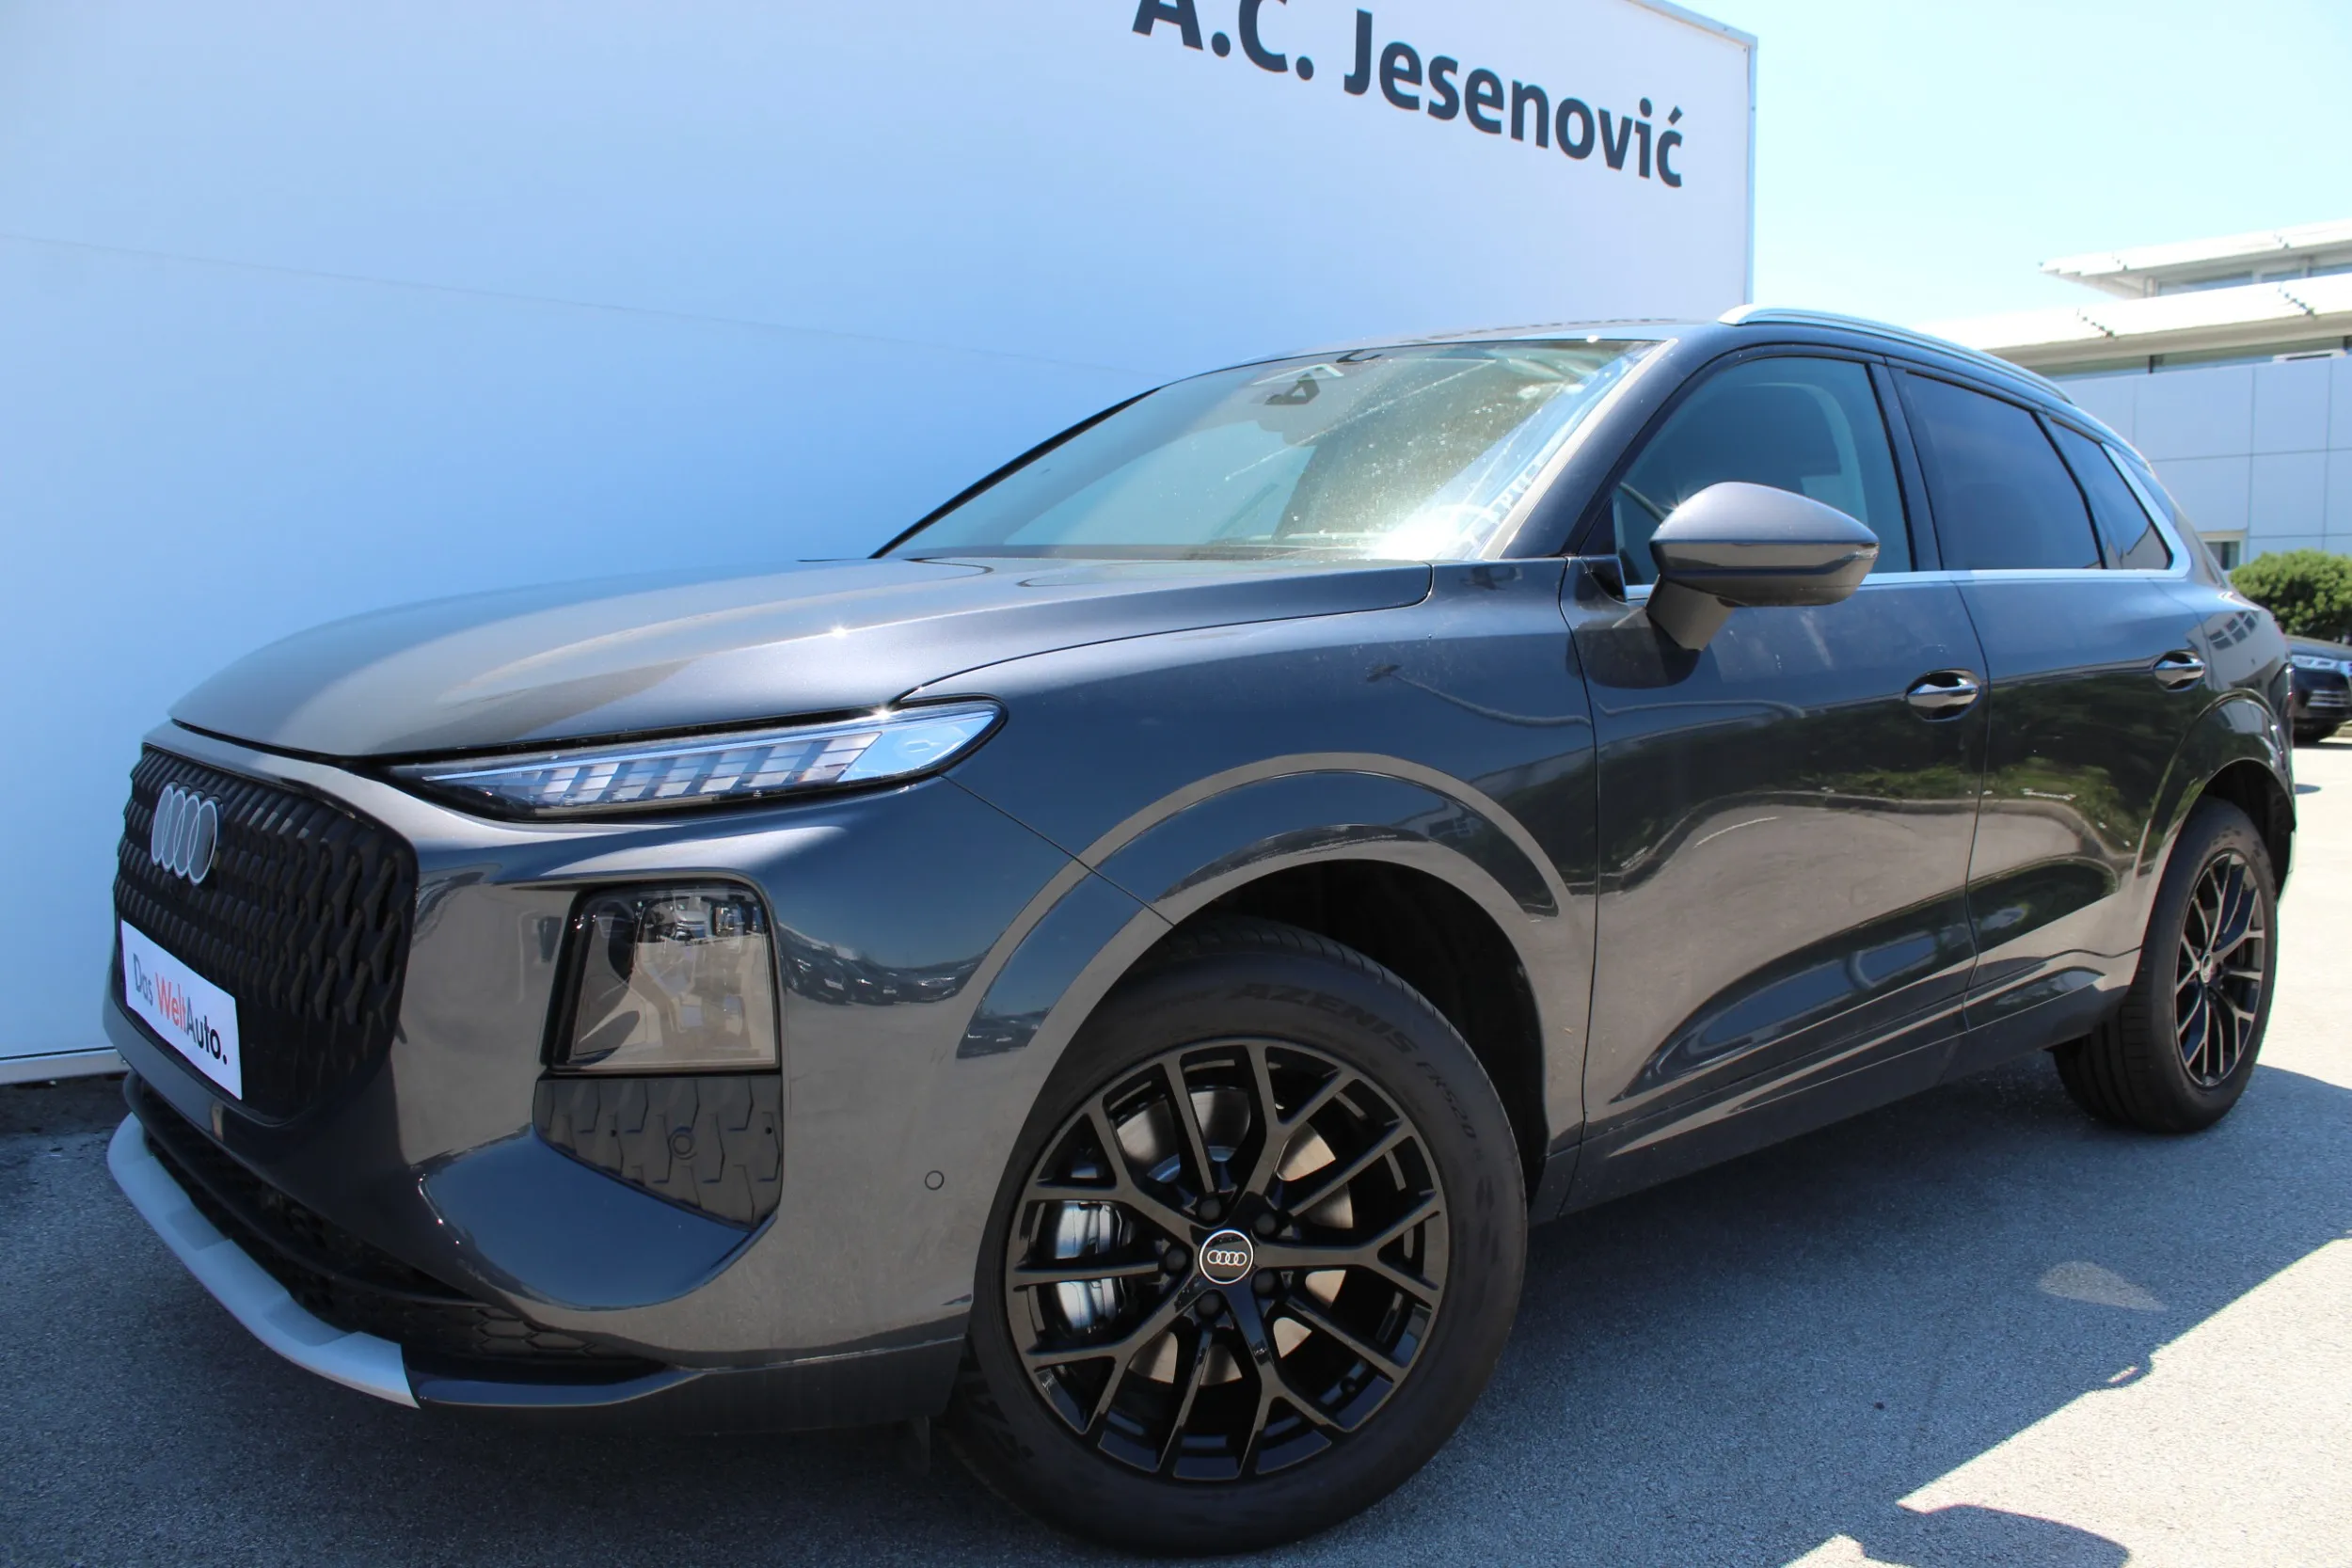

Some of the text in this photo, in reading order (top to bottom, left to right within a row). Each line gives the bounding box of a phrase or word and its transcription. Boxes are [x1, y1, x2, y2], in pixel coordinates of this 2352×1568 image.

[1343, 8, 1683, 188] Jesenović
[133, 952, 154, 1007] Das
[1224, 982, 1420, 1054] AZENIS
